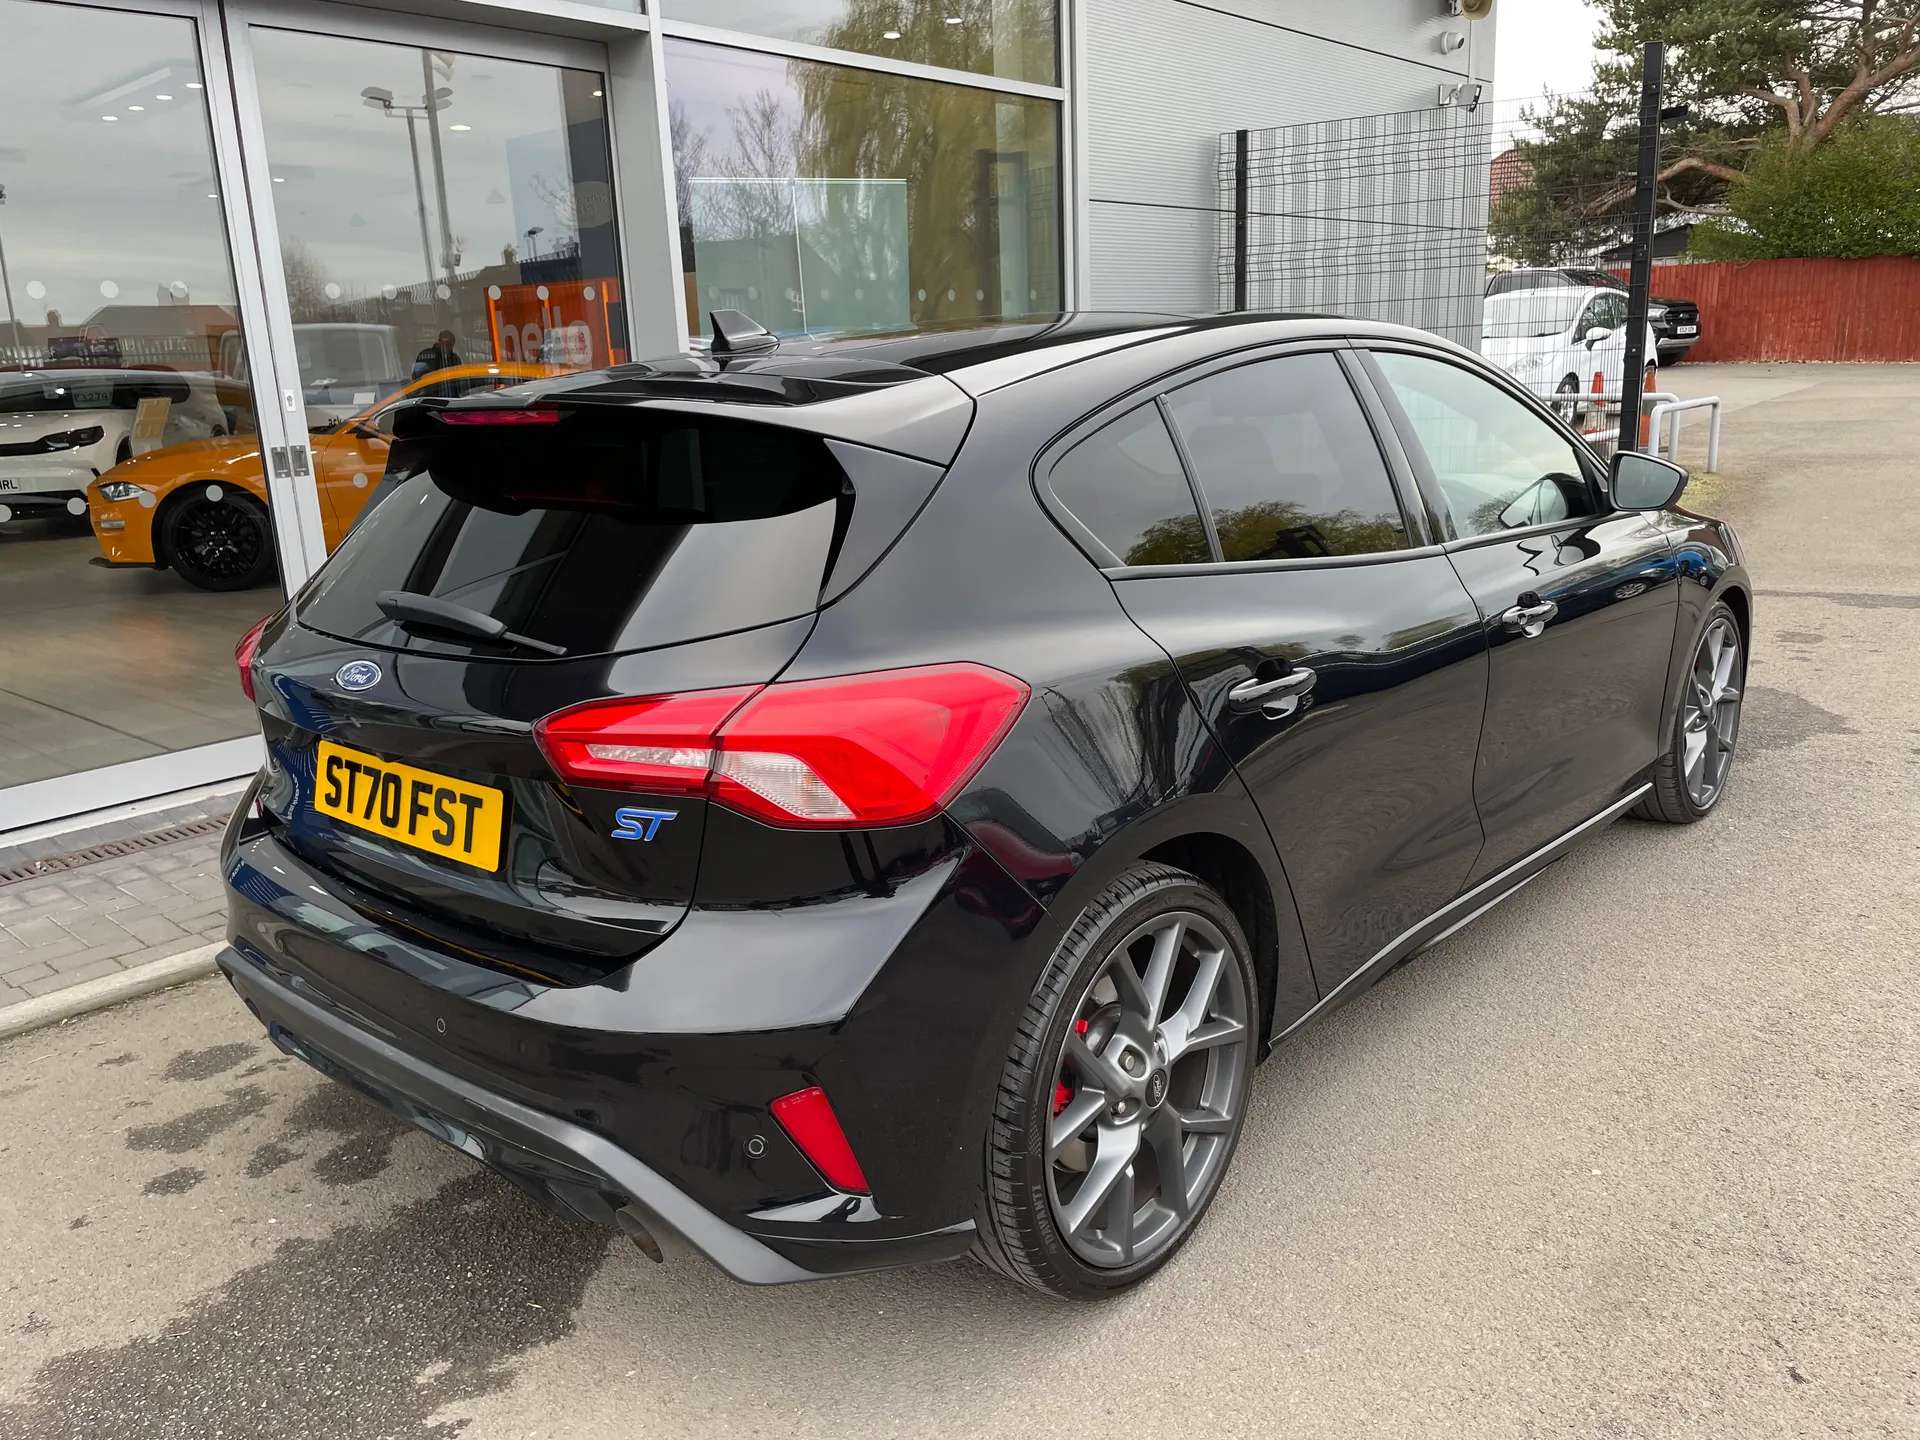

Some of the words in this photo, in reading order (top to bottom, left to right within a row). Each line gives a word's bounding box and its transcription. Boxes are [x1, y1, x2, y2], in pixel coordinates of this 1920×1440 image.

[496, 306, 592, 364] hello
[325, 755, 402, 828] ST70
[408, 779, 483, 854] FST
[611, 807, 679, 841] ST
